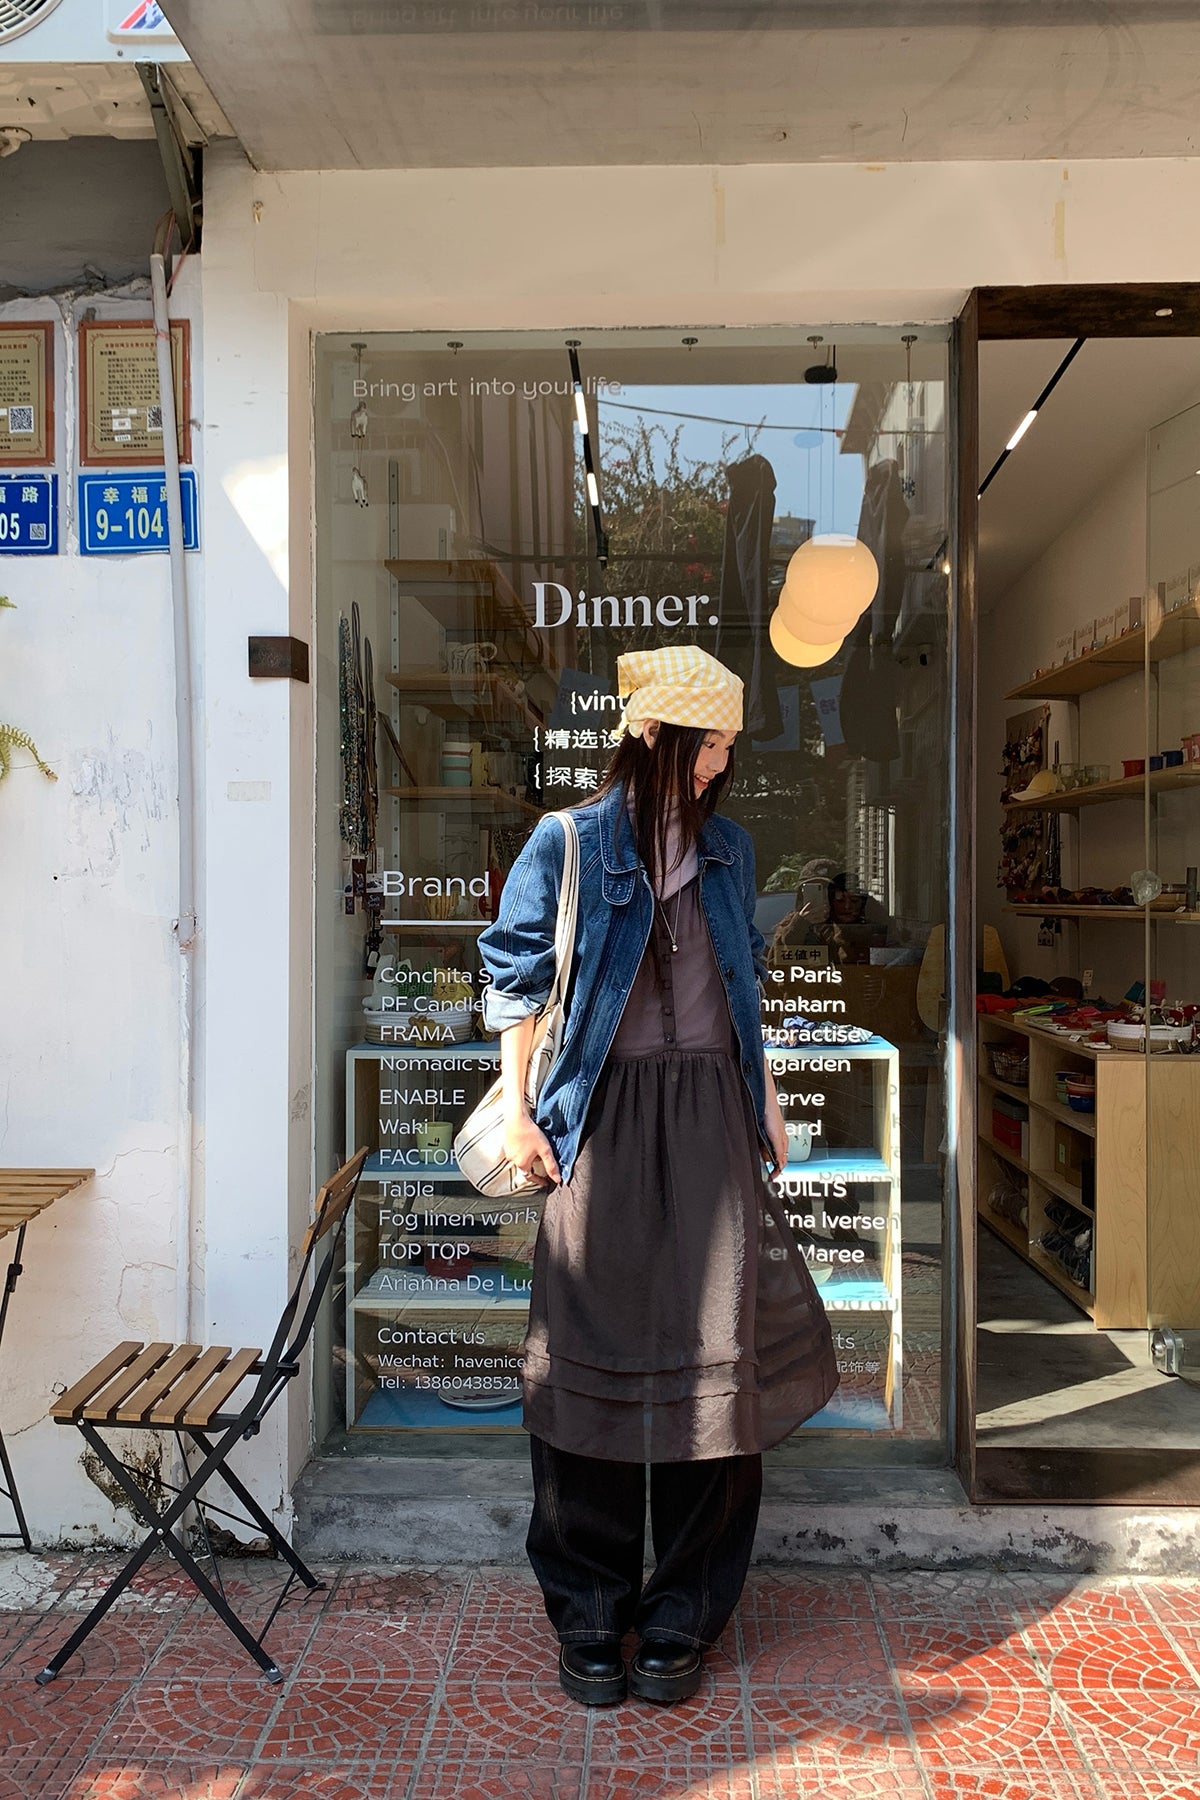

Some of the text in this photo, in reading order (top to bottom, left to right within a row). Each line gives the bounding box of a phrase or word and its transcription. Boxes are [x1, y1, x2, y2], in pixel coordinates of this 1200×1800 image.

[352, 377, 416, 401] Bring
[423, 378, 458, 397] art
[470, 377, 515, 396] into
[522, 380, 580, 400] your
[95, 507, 164, 541] 9-104
[531, 582, 719, 628] Dinner.
[382, 870, 490, 897] Brand
[379, 967, 473, 984] Conchita
[790, 966, 843, 984] Paris
[381, 995, 483, 1013] PF Candle
[379, 1025, 456, 1041] FRAMA
[379, 1055, 474, 1072] Nomadic
[379, 1089, 466, 1105] ENABLE
[776, 1093, 826, 1106] erve
[378, 1118, 429, 1135] Waki
[378, 1180, 434, 1198] Table
[378, 1207, 538, 1231] Fog linen work
[378, 1242, 471, 1260] TOP TOP
[797, 1243, 865, 1263] Maree
[378, 1275, 461, 1292] Arianna
[466, 1275, 495, 1292] De
[377, 1327, 485, 1345] Contact us
[377, 1375, 520, 1390] Tel: 13860438521
